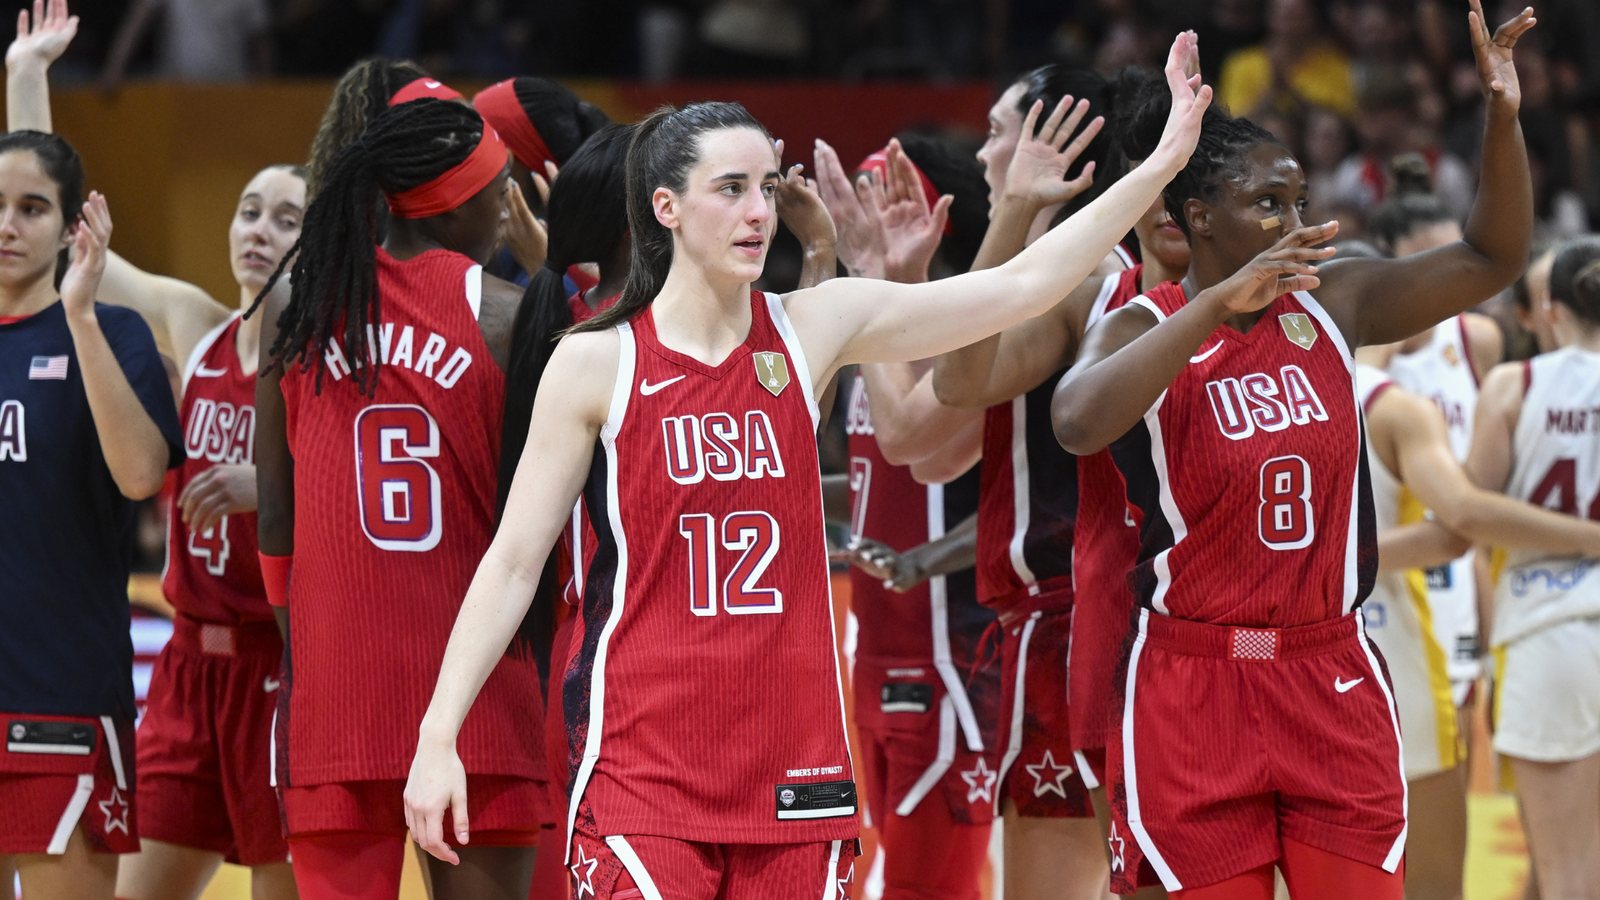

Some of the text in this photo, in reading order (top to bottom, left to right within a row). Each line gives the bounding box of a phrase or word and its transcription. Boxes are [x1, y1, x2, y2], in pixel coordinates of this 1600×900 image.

[319, 322, 472, 389] HWARD
[185, 398, 257, 465] USA
[1206, 365, 1329, 440] USA
[354, 403, 442, 552] 6
[662, 410, 785, 485] USA
[1258, 455, 1315, 550] 8
[188, 514, 230, 576] 4
[680, 511, 783, 616] 12
[787, 765, 843, 777] EMBERS OF DYNASTY
